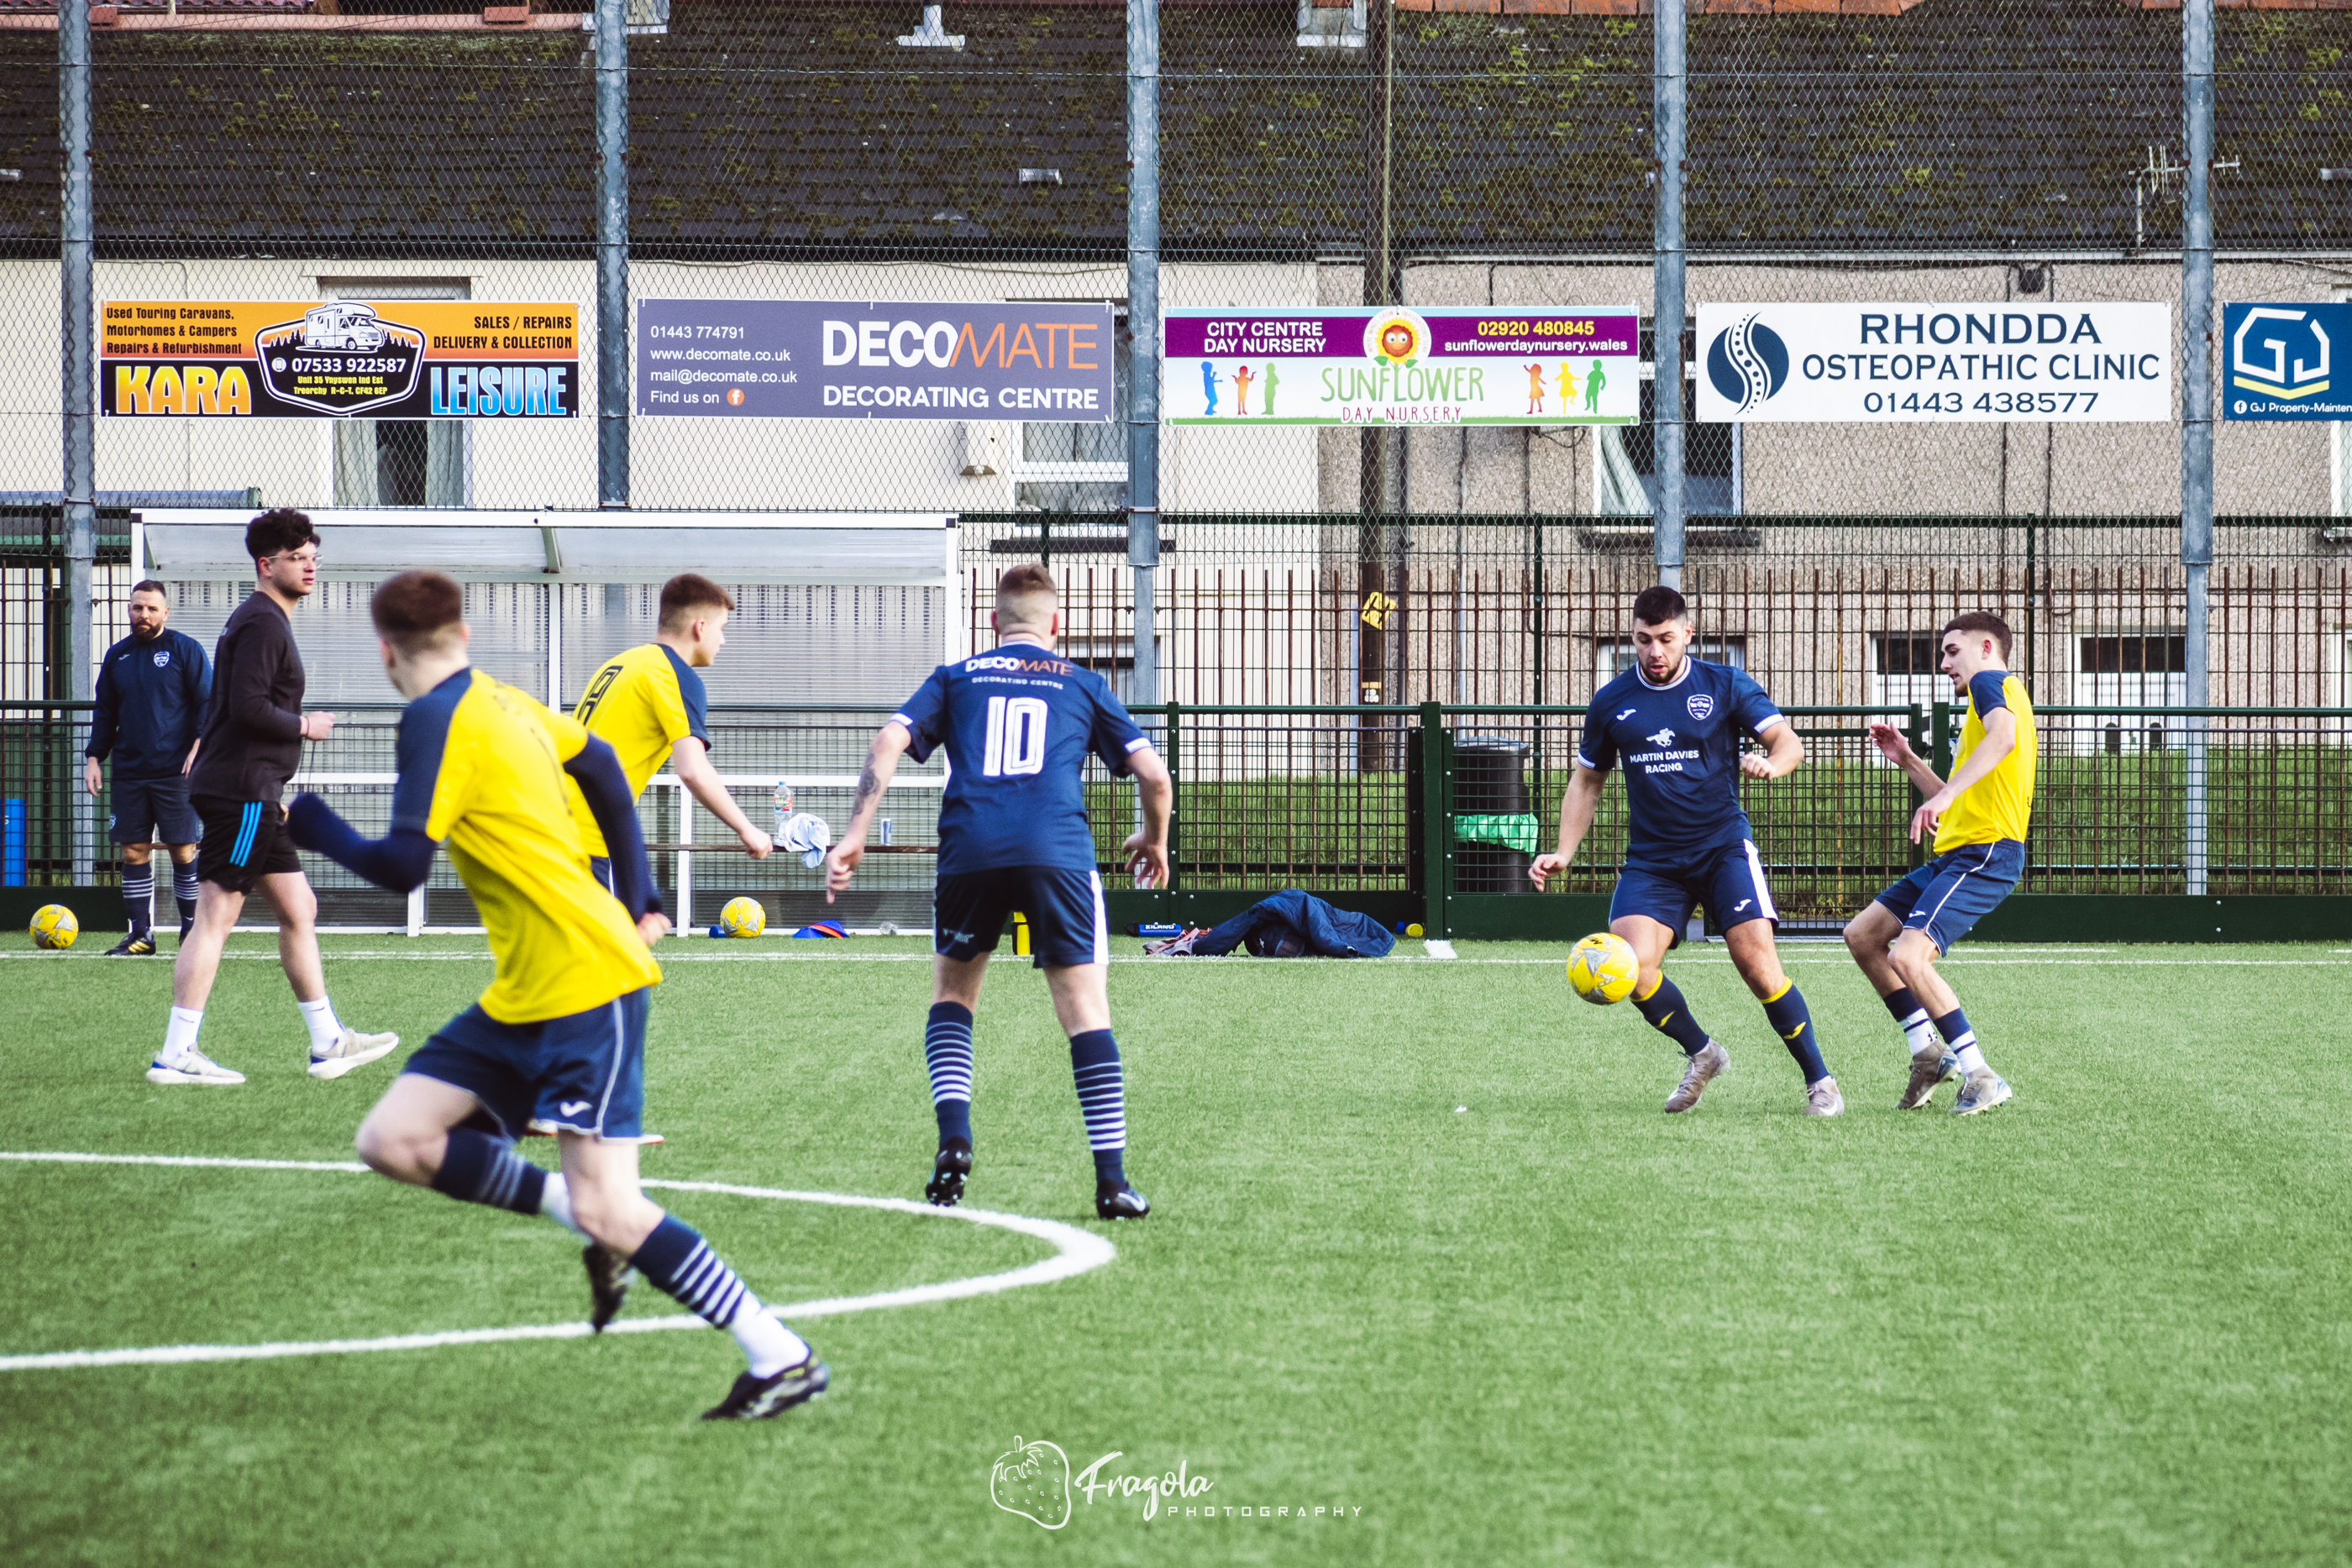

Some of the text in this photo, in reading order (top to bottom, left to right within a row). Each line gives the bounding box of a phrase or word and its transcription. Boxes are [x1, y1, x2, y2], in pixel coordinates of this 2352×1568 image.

[107, 308, 132, 319] Used
[136, 308, 176, 320] Touring
[474, 316, 572, 330] SALES / REPAIRS
[1207, 322, 1323, 336] CITY CENTRE
[1478, 321, 1595, 336] 02920 480845
[1860, 313, 2103, 344] RHONDDA
[107, 325, 237, 337] Motorhomes & Campers
[650, 326, 744, 339] 01443 774791
[107, 343, 242, 354] Repairs & Refurbishment
[434, 336, 572, 349] DELIVERY & COLLECTION
[823, 320, 1098, 369] DECOMATE
[1204, 338, 1326, 353] DAY NURSERY
[1445, 339, 1628, 354] sunflowerdaynursery.wales
[650, 348, 791, 361] www.decomate.co.uk
[291, 358, 407, 372] 07533 922587
[1803, 354, 2160, 380] OSTEOPATHIC CLINIC
[650, 370, 798, 384] mail@decomate.co.uk
[116, 366, 252, 414] KARA
[430, 366, 567, 416] LEISURE
[1320, 367, 1484, 402] SUNFLOWER
[651, 391, 679, 403] Find
[684, 393, 699, 403] us
[703, 394, 719, 403] on
[823, 385, 1099, 409] DECORATING CENTRE
[1864, 392, 2099, 413] 01443 438577
[1343, 406, 1461, 421] DAY NURSERY
[2250, 403, 2266, 412] GJ
[965, 656, 1074, 676] DECOMATE
[971, 676, 1064, 690] DECORATING CENTRE
[983, 696, 1048, 776] 10
[1630, 750, 1699, 763] MARTIN DAVIES
[1645, 763, 1683, 774] RACING
